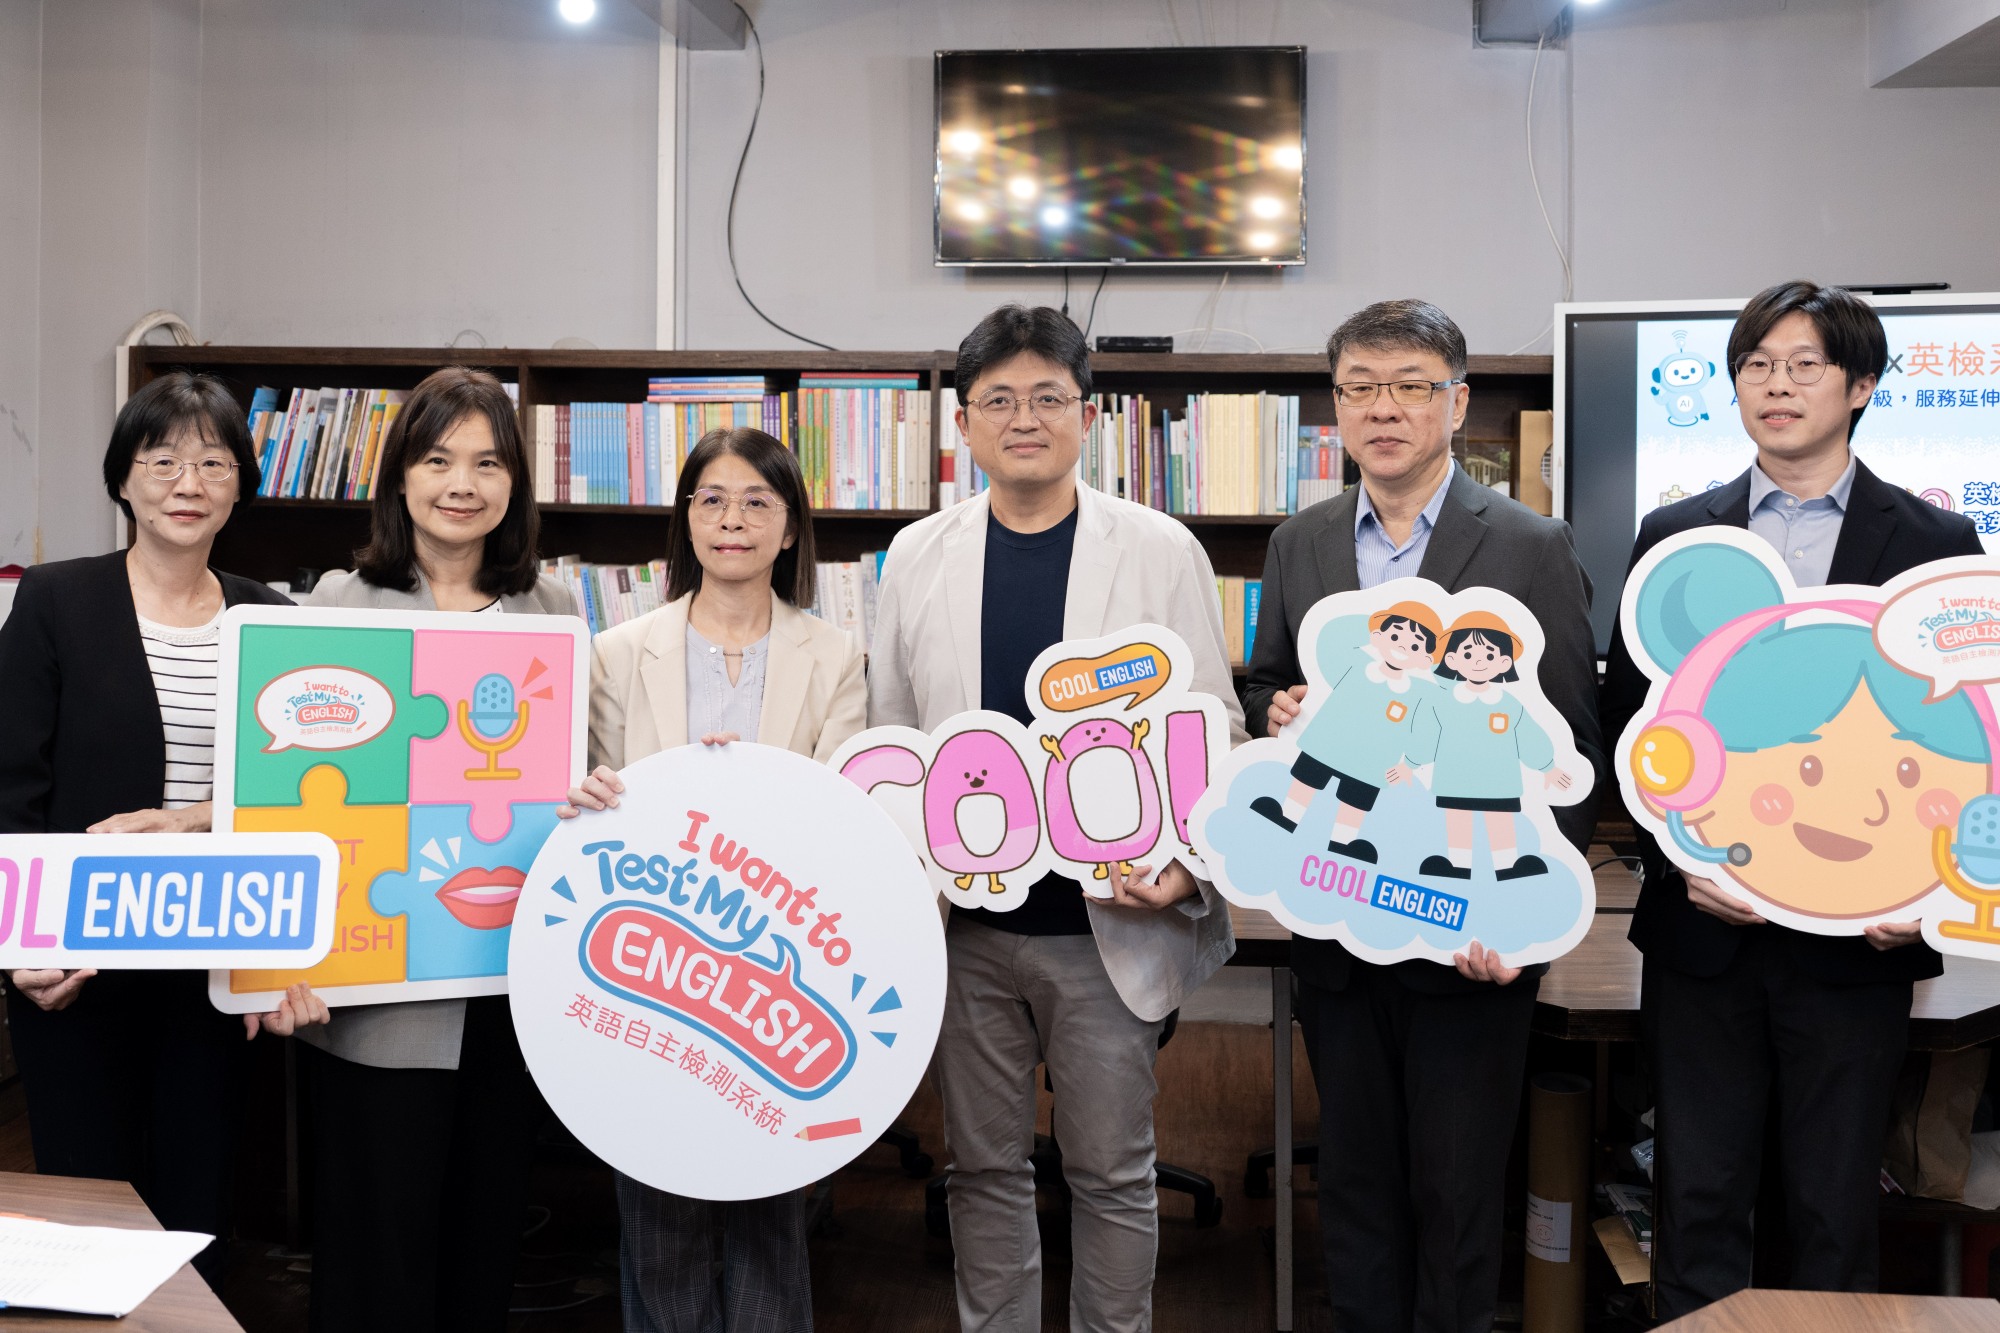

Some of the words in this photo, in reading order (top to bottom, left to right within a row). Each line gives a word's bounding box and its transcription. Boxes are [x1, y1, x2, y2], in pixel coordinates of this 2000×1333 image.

[1679, 399, 1690, 408] AI
[1919, 608, 1954, 631] Test
[1955, 608, 1978, 624] My
[1938, 597, 1948, 609] I
[1950, 596, 1986, 608] want
[287, 691, 313, 708] Test
[314, 691, 331, 703] My
[304, 682, 310, 691] I
[312, 683, 338, 693] want
[339, 685, 349, 696] to
[1049, 671, 1098, 702] COOL
[1099, 659, 1154, 687] ENGLISH
[301, 707, 354, 721] ENGLISH
[82, 870, 305, 939] ENGLISH
[581, 840, 699, 906] Test
[694, 874, 770, 946] My
[678, 810, 709, 853] I
[709, 833, 818, 926] want
[807, 912, 852, 967] to
[1300, 854, 1369, 904] COOL
[1377, 881, 1463, 927] ENGLISH
[611, 921, 832, 1074] ENGLISH
[564, 993, 787, 1136] 英語自主檢測系統
